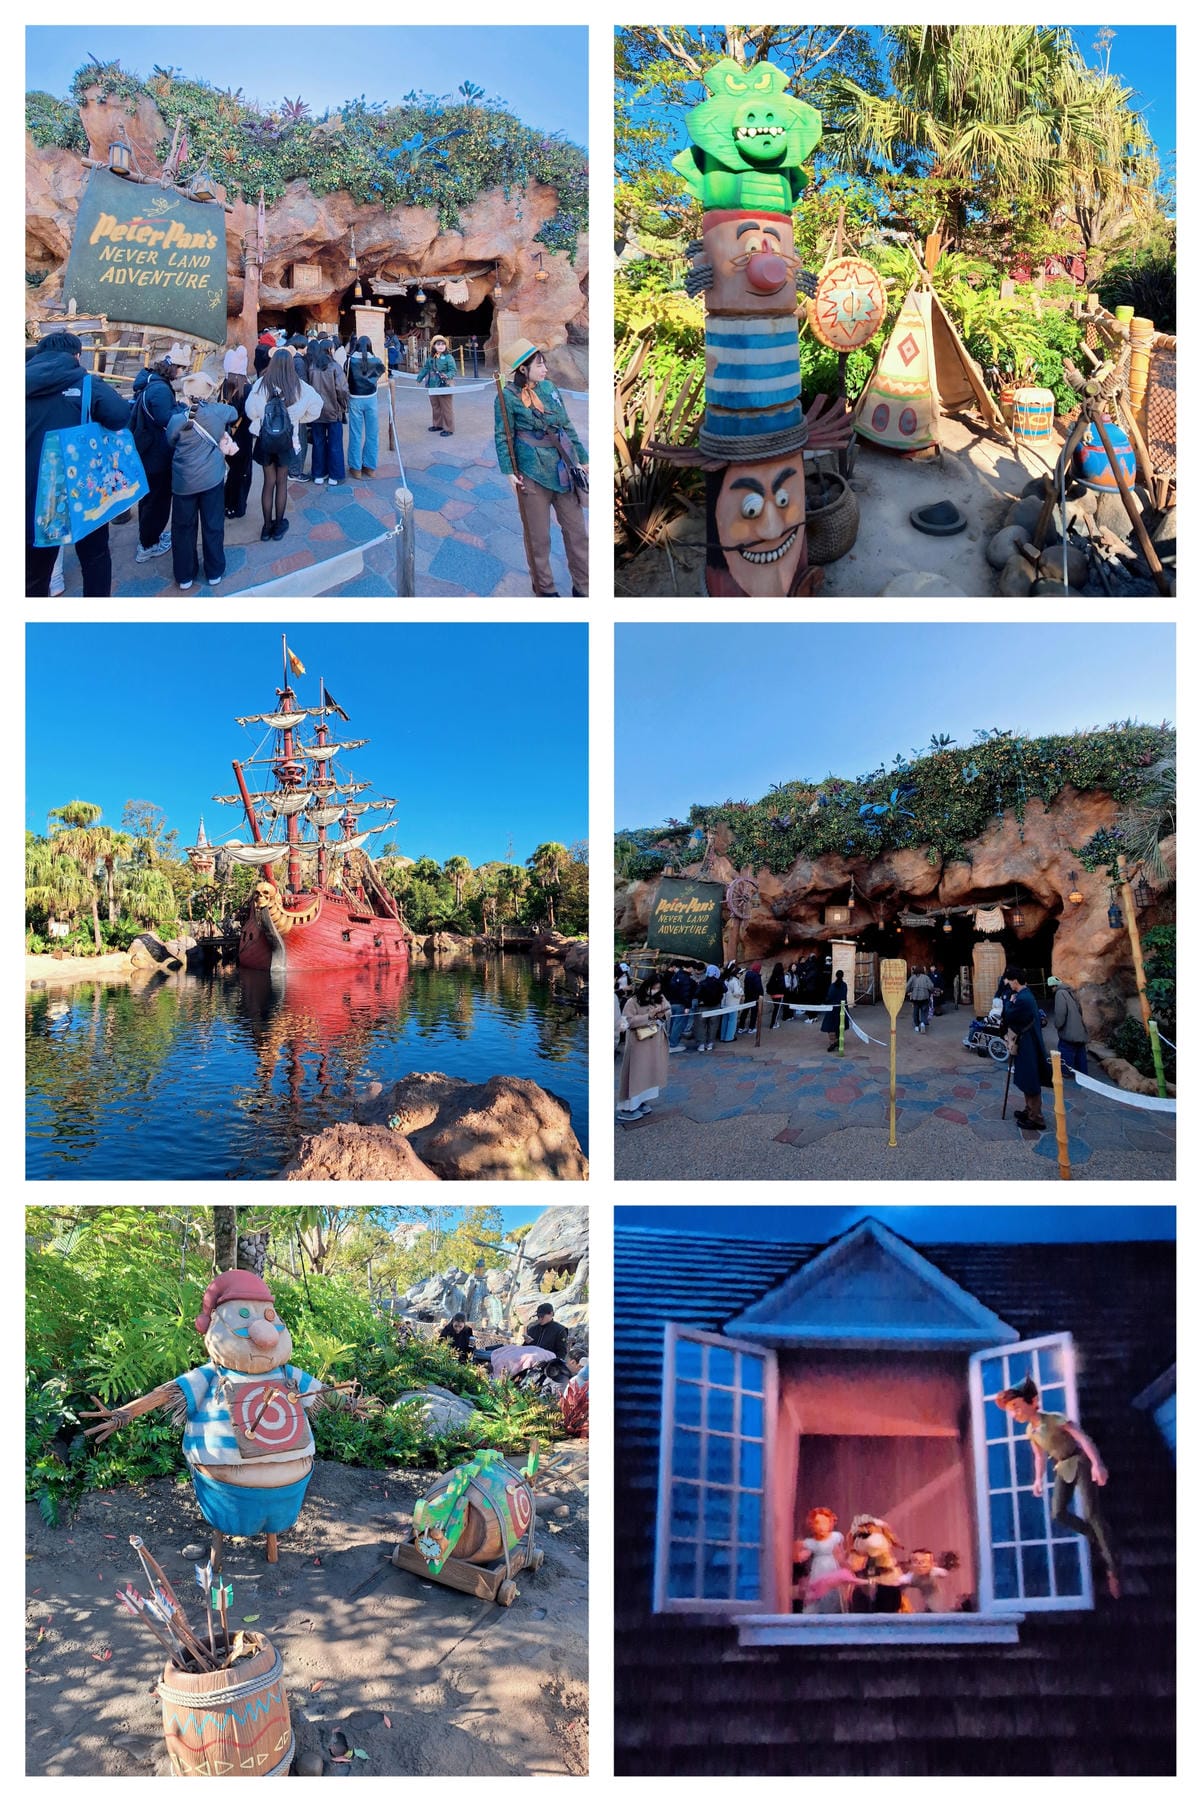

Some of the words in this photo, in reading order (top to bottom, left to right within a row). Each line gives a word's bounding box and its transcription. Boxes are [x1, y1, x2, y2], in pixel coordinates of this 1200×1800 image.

[89, 212, 166, 246] Peter
[162, 219, 218, 250] Pan's
[99, 245, 159, 265] NEVER
[168, 252, 211, 269] LAND
[99, 266, 211, 290] ADVENTURE
[655, 897, 688, 915] Peter
[685, 897, 715, 914] Pan's
[658, 914, 683, 923] NEVER
[686, 914, 710, 923] LAND
[658, 924, 708, 935] ADVENTURE
